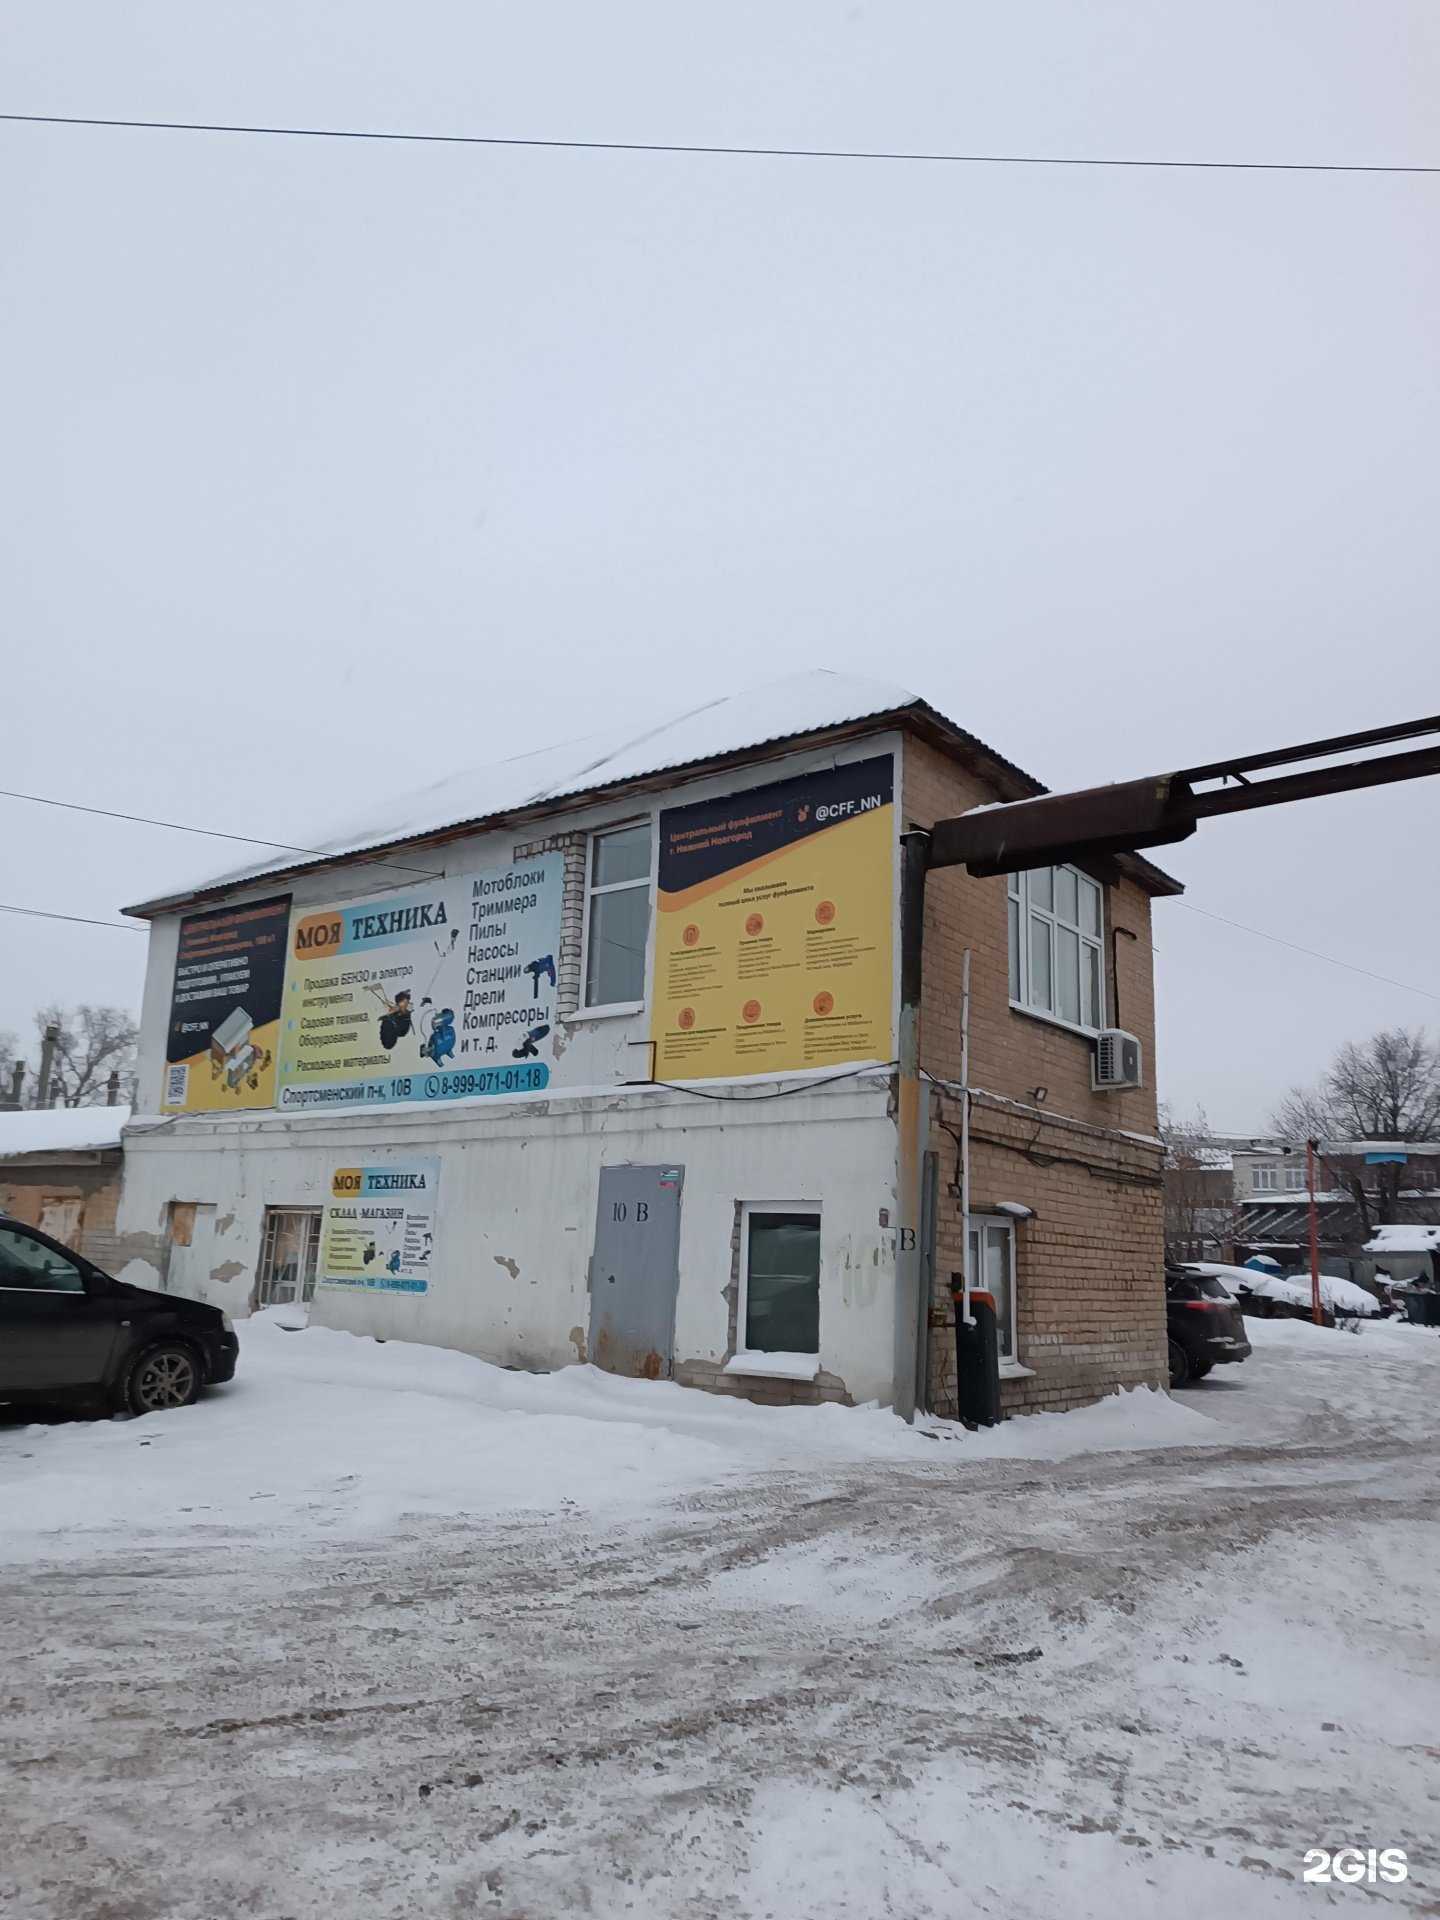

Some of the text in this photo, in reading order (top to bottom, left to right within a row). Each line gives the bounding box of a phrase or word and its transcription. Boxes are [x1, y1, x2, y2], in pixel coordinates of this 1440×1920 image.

[815, 794, 881, 821] @CFF_NN
[472, 869, 545, 898] Мотоблоки
[471, 893, 537, 922] Триммера
[295, 922, 342, 950] МОЯ
[351, 901, 448, 941] ТЕХНИКА
[469, 922, 507, 942] Пилы
[467, 942, 519, 964] Насосы
[304, 965, 414, 993] Продажа БЕНЗО и электро
[466, 963, 522, 986] Станции
[463, 989, 506, 1011] Дрели
[301, 1017, 335, 1029] Садовая
[462, 1005, 550, 1031] Компресоры
[299, 1031, 358, 1049] Оборудование
[461, 1039, 469, 1053] и
[343, 1054, 391, 1069] материалы
[441, 1068, 541, 1096] 8-999-071-01-18
[282, 1083, 365, 1107] Спортсменский
[333, 1174, 426, 1190] МОЯ ТЕХНИКА
[612, 1202, 627, 1222] 10
